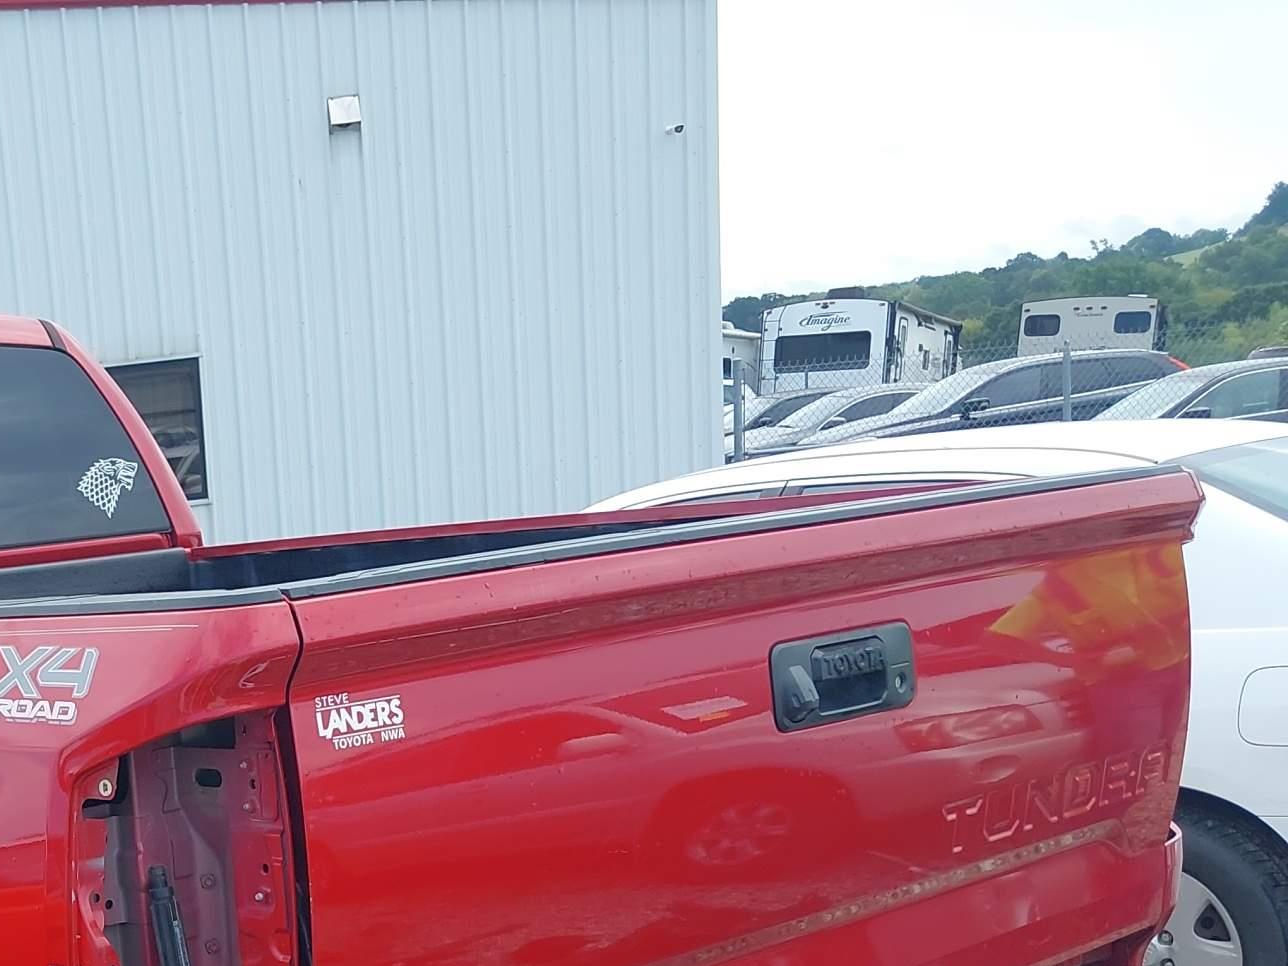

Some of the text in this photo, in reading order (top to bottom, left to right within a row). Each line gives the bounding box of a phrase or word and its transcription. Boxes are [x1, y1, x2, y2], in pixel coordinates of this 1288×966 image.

[799, 313, 851, 331] Imagine
[823, 647, 886, 677] TOYOTA
[315, 692, 349, 708] STEVE
[316, 699, 404, 739] LANDERS
[333, 727, 405, 750] TOYOTA NWA
[941, 742, 1171, 854] TUNDRA
